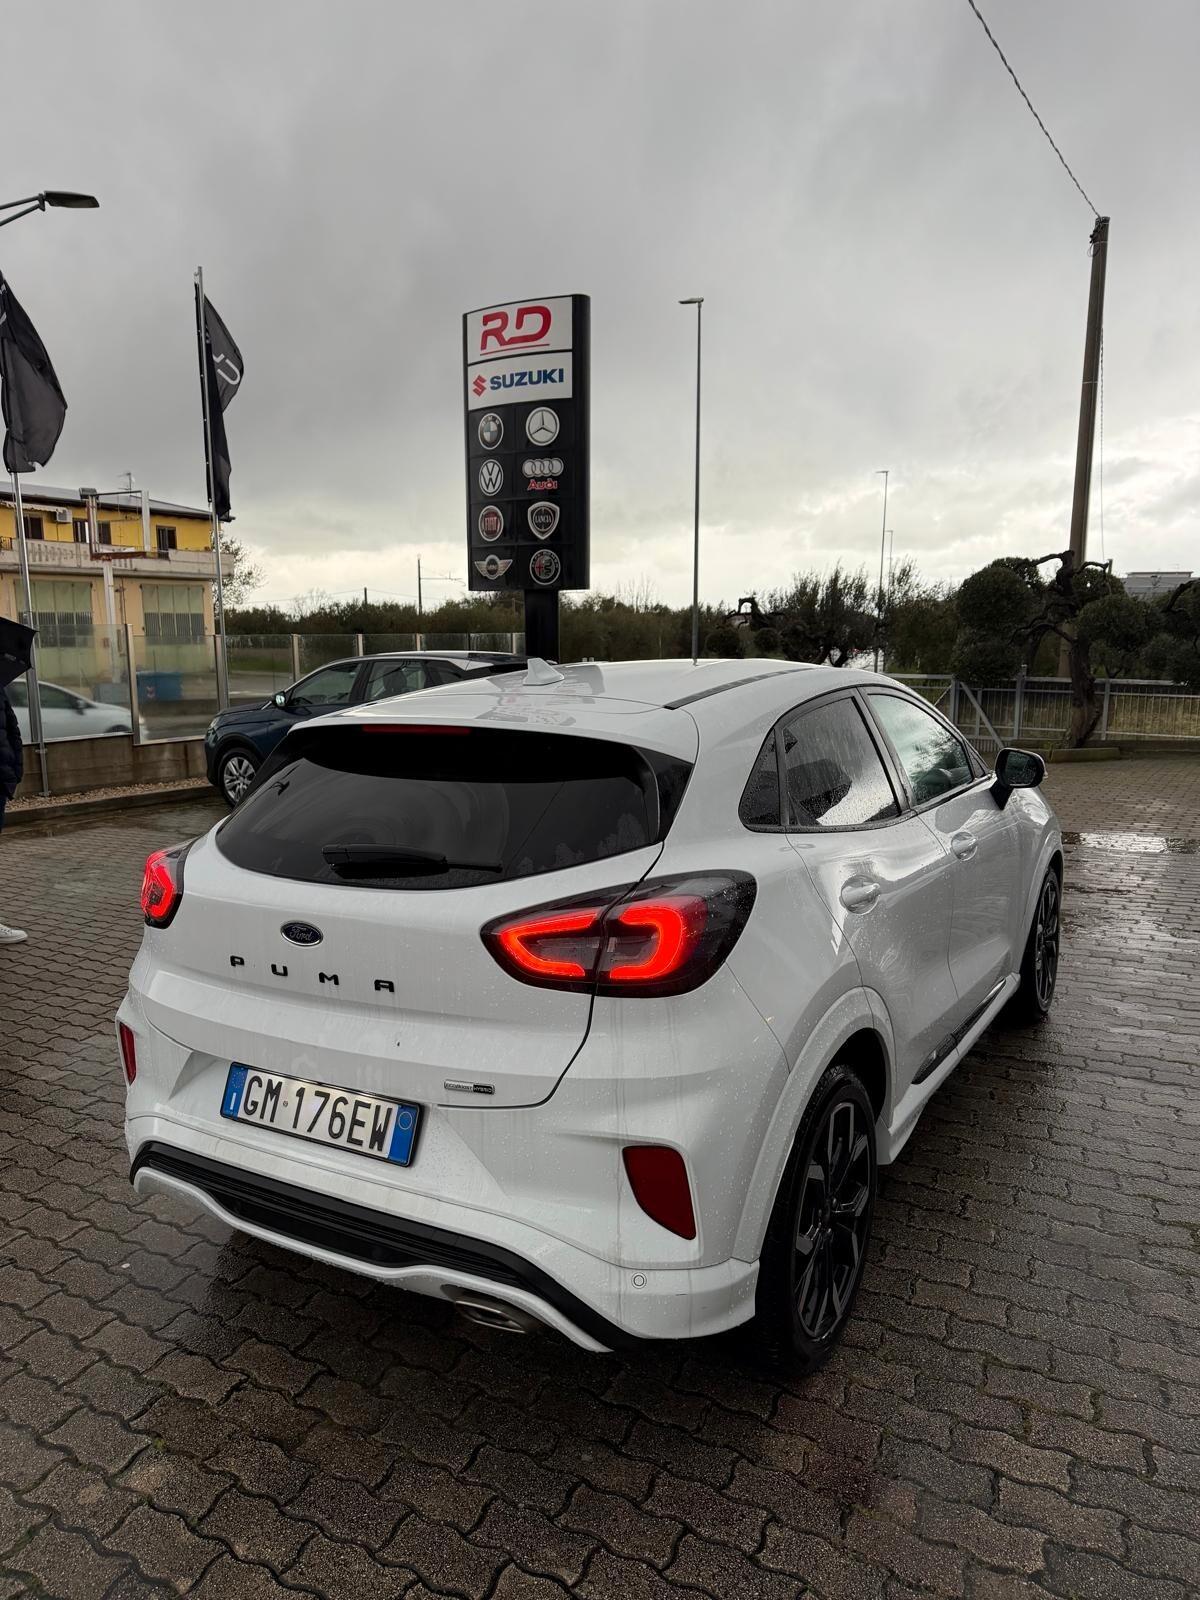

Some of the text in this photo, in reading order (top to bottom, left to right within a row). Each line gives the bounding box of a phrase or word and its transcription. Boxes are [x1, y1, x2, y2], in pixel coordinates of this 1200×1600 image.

[480, 305, 552, 351] RD
[490, 367, 564, 391] SUZUKI
[527, 477, 558, 491] Audi
[288, 924, 314, 942] Ford
[229, 954, 396, 993] PUMA
